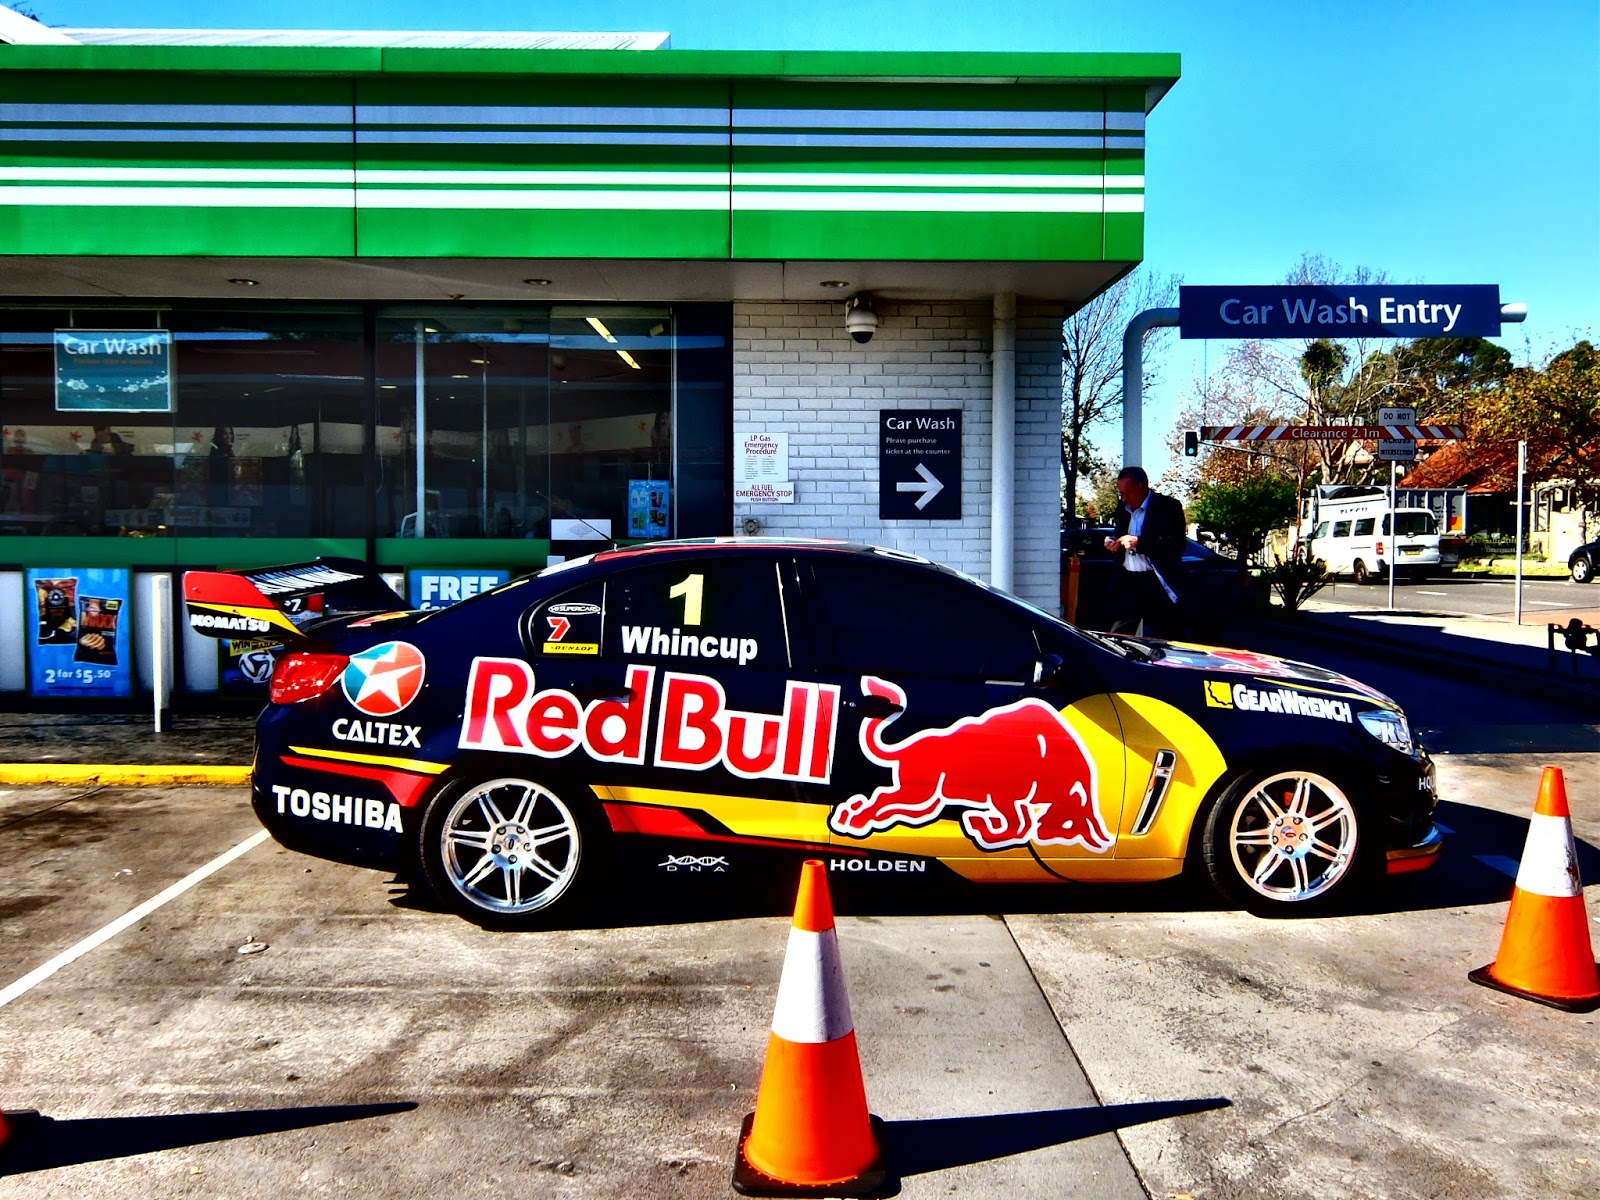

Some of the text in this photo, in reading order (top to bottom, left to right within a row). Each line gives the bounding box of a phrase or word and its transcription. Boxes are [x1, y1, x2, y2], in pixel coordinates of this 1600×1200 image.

[1219, 297, 1462, 332] Car Wash Entry
[64, 337, 162, 355] Car Wash
[886, 416, 955, 430] Car Wash
[1292, 428, 1380, 438] Clearance 2.1m
[668, 574, 704, 626] 1
[190, 614, 270, 632] KOMATSU
[546, 616, 571, 642] 7
[232, 641, 250, 649] WIN
[621, 626, 758, 665] Whincup
[45, 669, 56, 683] 2
[57, 669, 72, 678] for
[458, 656, 840, 785] Red Bull
[332, 718, 422, 749] CALTEX
[272, 784, 404, 834] TOSHIBA
[830, 858, 926, 872] HOLDEN
